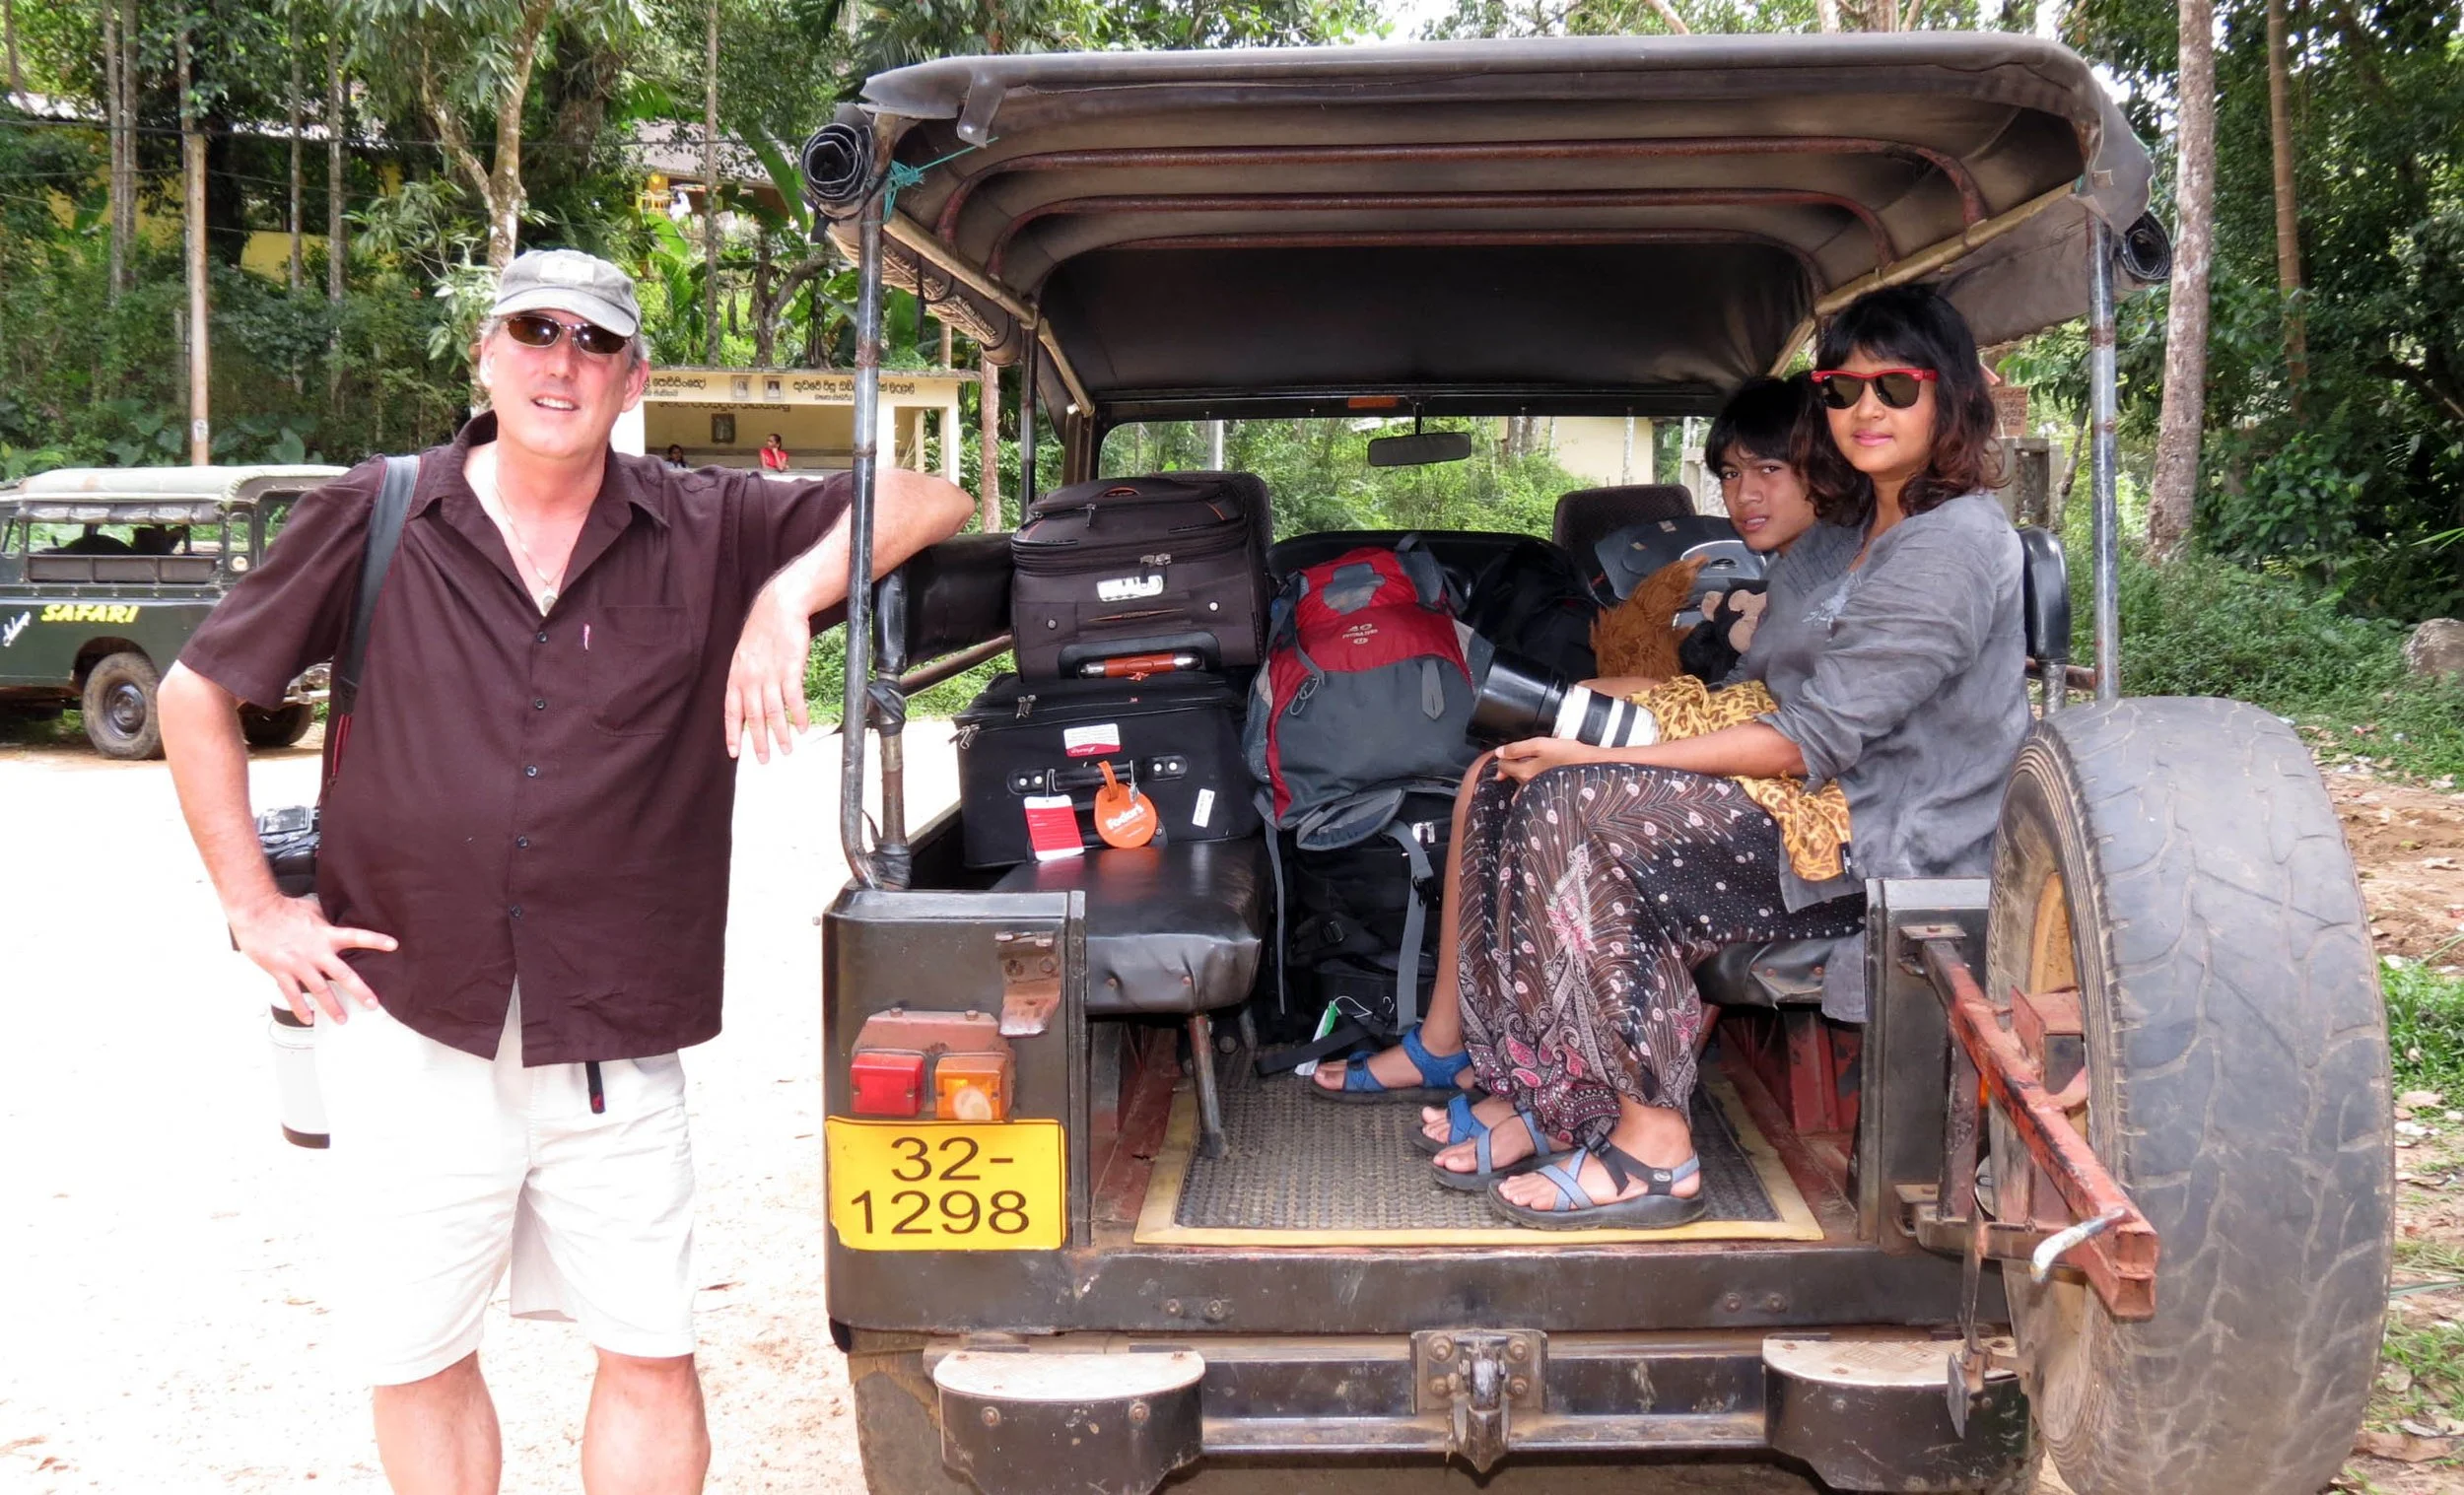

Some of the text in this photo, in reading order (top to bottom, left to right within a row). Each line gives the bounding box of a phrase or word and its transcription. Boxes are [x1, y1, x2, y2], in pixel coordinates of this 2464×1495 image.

[40, 604, 140, 623] SAFARI
[890, 1136, 1014, 1182] 32-
[851, 1189, 1029, 1234] 1298
